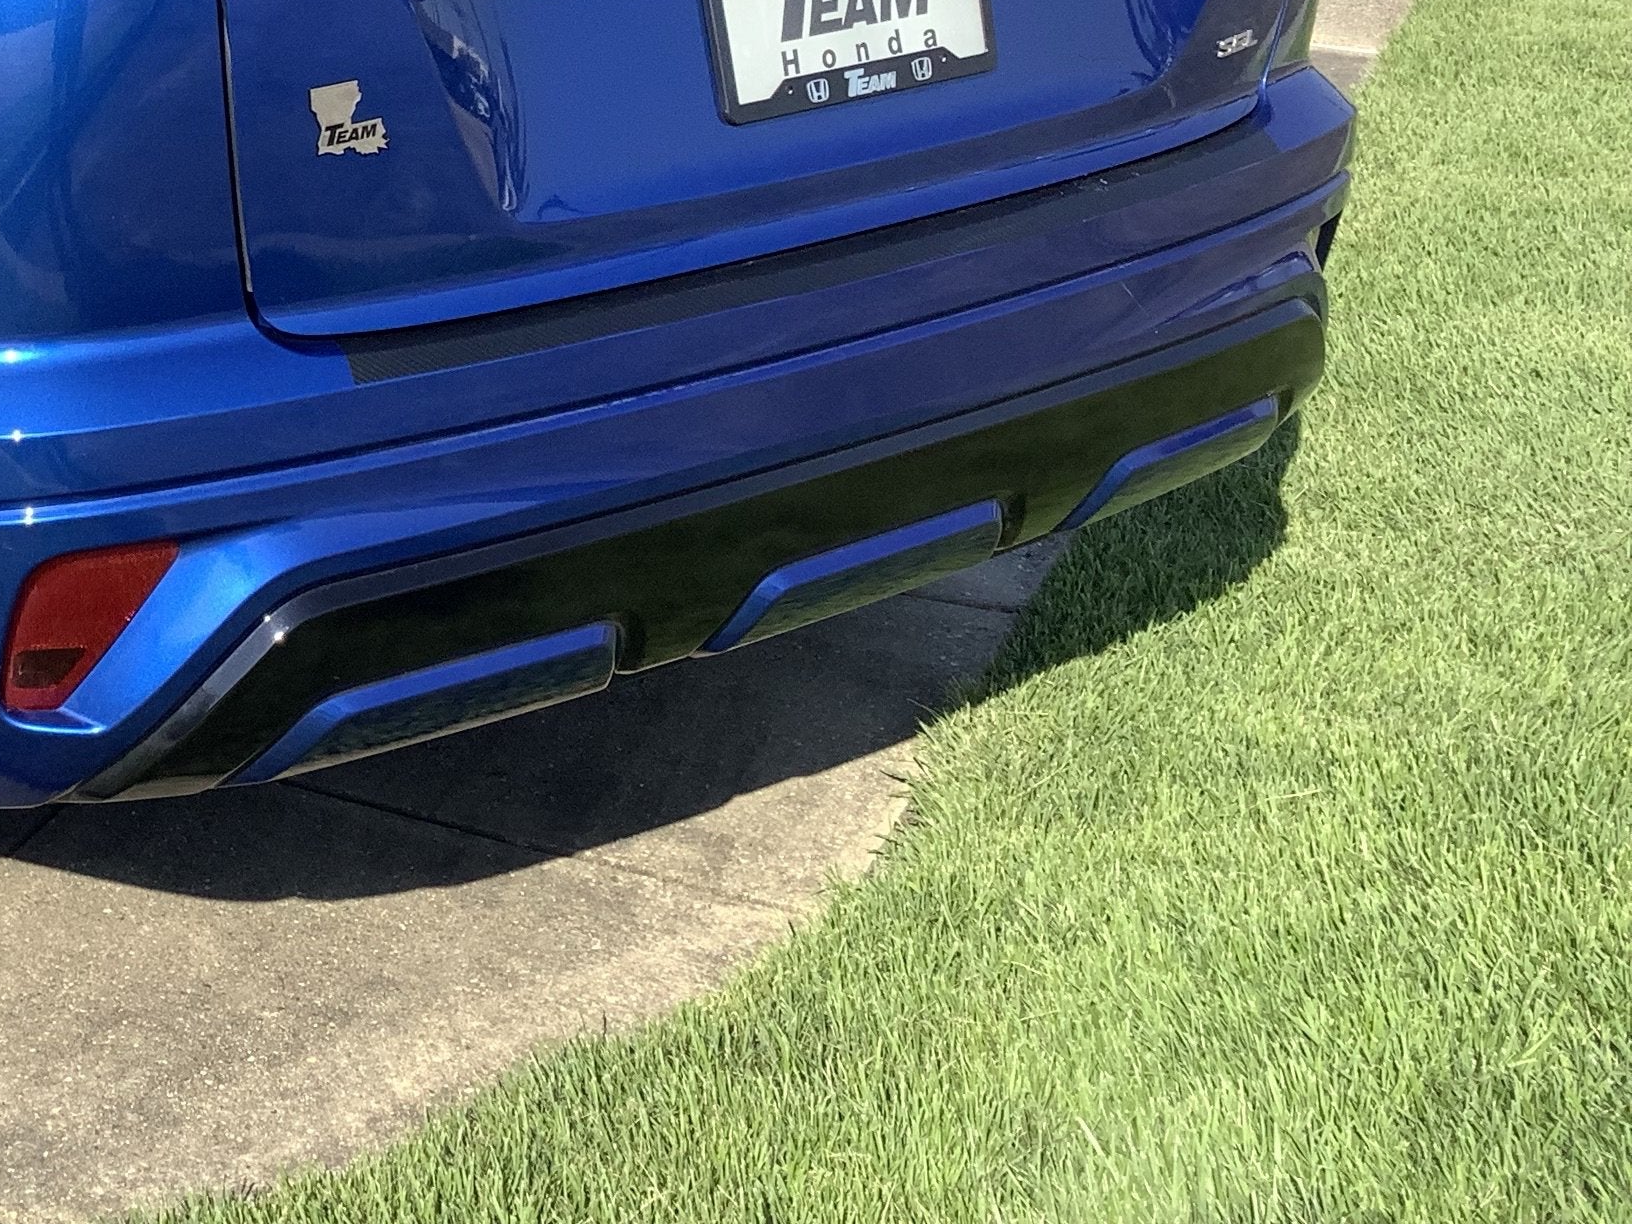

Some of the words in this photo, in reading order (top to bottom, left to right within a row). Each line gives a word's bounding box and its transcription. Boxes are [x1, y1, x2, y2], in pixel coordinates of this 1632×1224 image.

[781, 28, 937, 77] Honda
[844, 68, 897, 98] TEAM
[325, 122, 377, 147] TEAM
